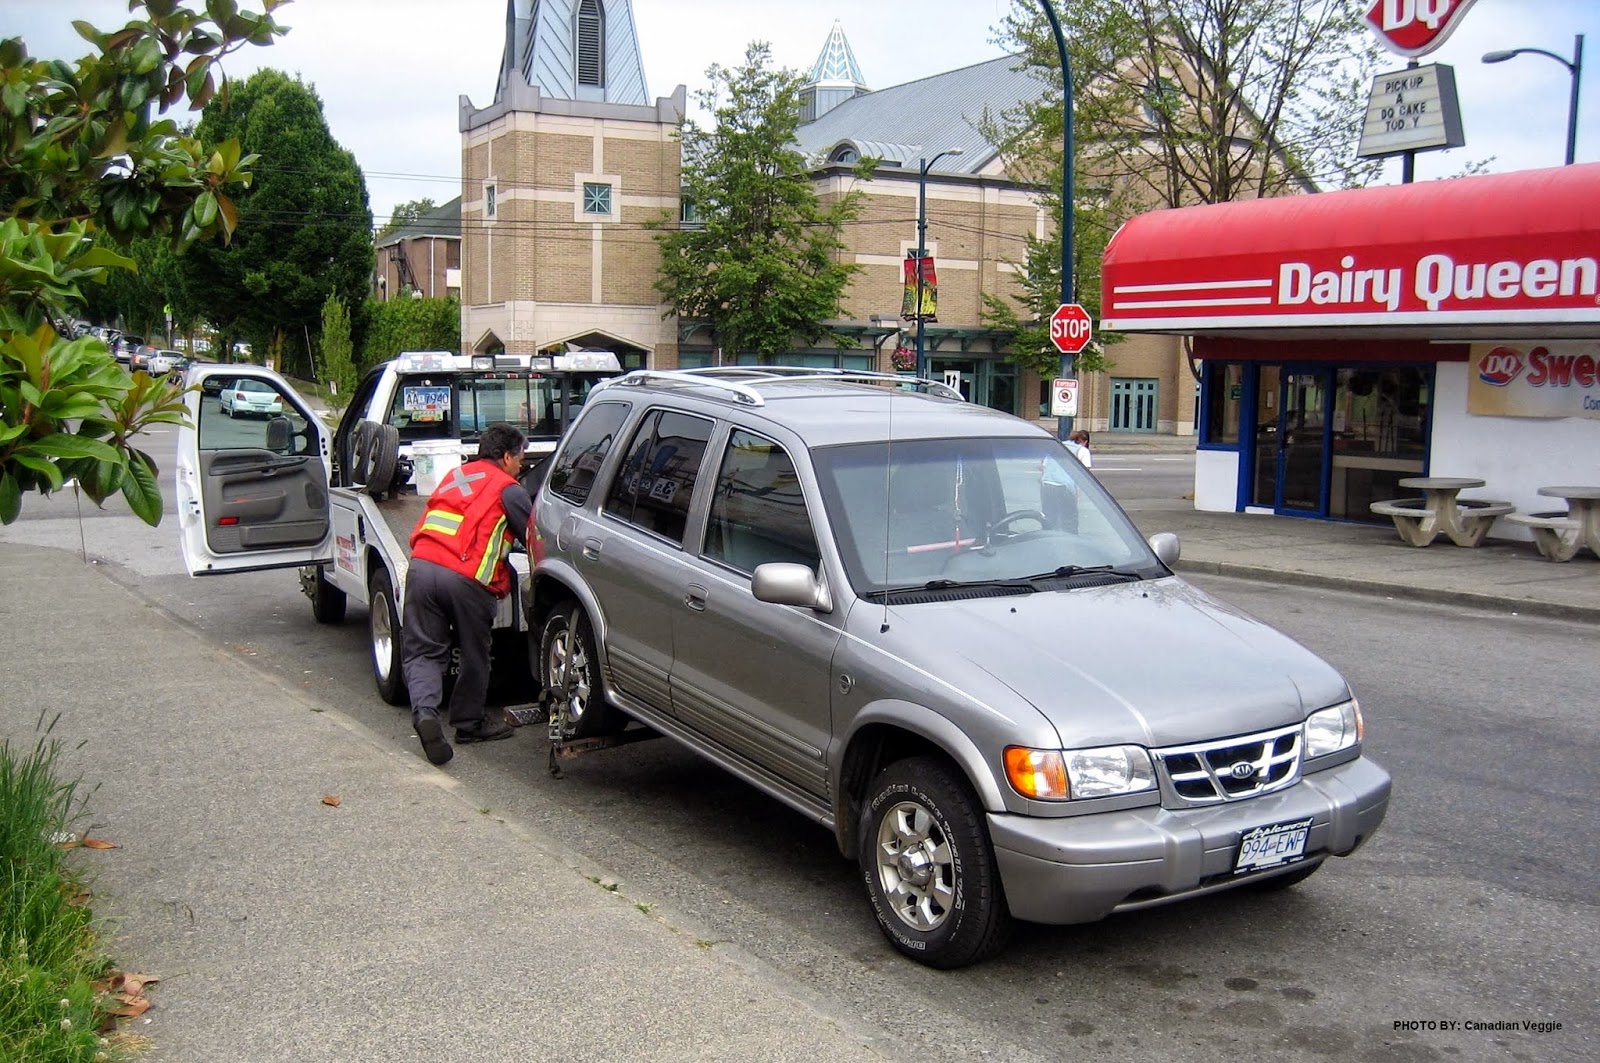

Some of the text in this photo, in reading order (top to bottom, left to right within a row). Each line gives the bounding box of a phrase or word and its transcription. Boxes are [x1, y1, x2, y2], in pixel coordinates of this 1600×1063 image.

[1382, 0, 1449, 31] DQ
[1396, 92, 1403, 105] A
[1399, 101, 1426, 116] CAKE
[1278, 254, 1597, 312] Dairy Queen
[1052, 319, 1090, 339] STOP
[1485, 346, 1600, 388] DQ Swe
[406, 391, 449, 405] AA 7940
[1235, 764, 1252, 776] KIA
[1243, 817, 1314, 840] Applewood
[1240, 830, 1307, 863] 994 EWP
